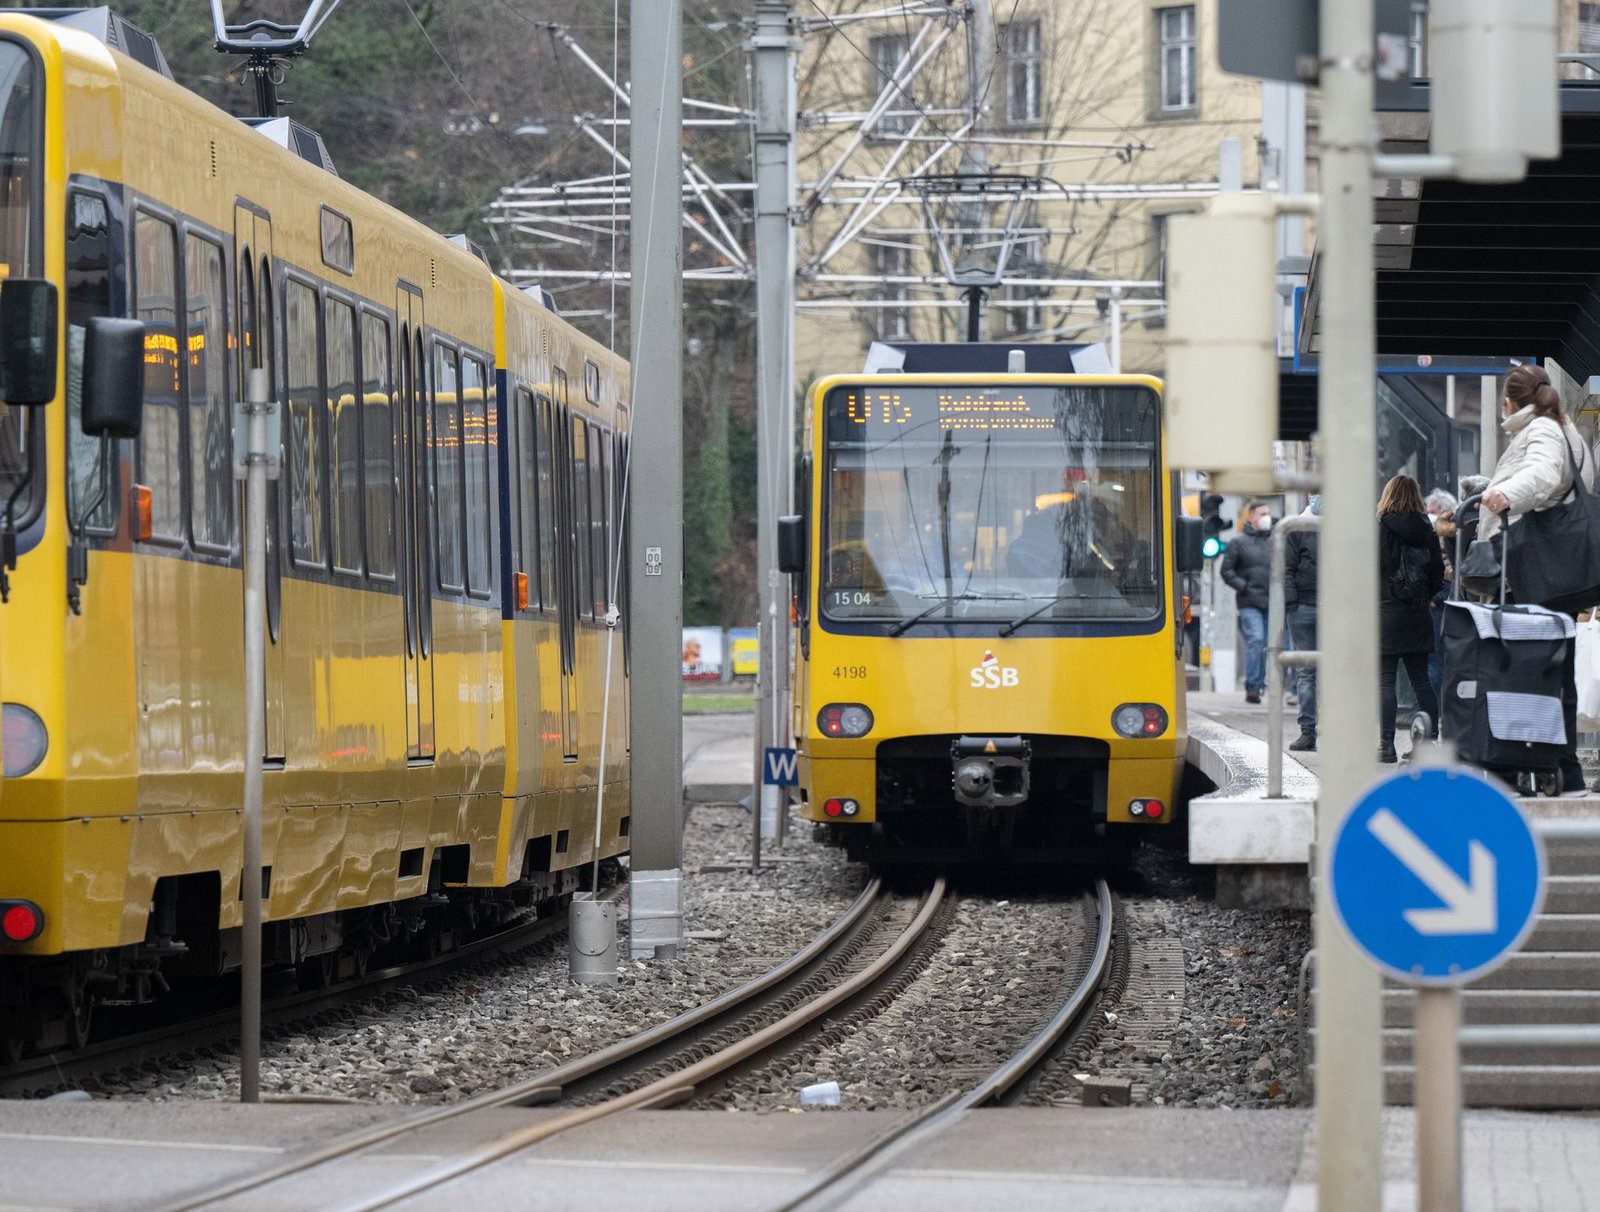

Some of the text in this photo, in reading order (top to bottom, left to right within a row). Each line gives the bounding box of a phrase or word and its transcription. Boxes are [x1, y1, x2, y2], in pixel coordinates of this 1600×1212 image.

[834, 592, 871, 605] 15 04
[832, 666, 867, 679] 4198
[970, 665, 1019, 689] SSB
[768, 752, 797, 781] W
